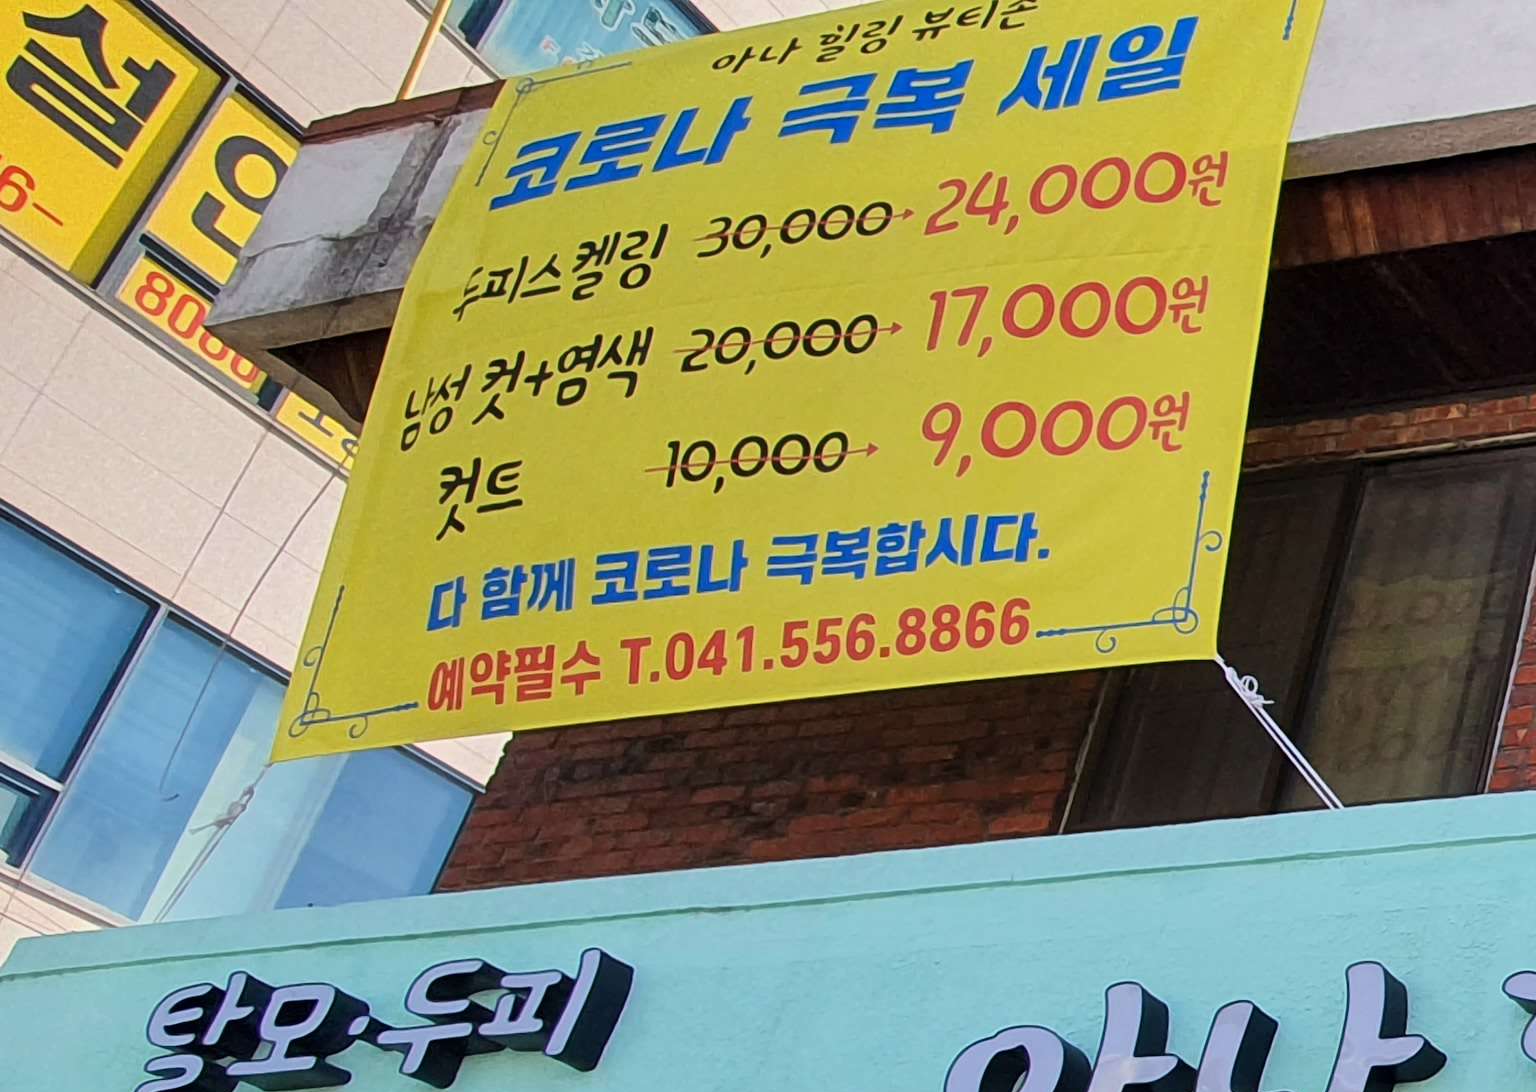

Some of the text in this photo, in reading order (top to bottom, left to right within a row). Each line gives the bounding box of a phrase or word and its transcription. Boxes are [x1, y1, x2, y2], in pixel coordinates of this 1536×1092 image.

[6, 4, 176, 170] 설
[489, 17, 1200, 211] 코로나 극복 세일
[712, 0, 1039, 73] 아나 힐링 뷰티존
[452, 150, 1230, 322] 두피스켈링 30,000 24,000원
[400, 362, 472, 453] 남성
[472, 326, 654, 427] 컷+염색
[680, 313, 879, 376] 20,000
[924, 275, 1208, 359] 17,000원
[435, 391, 1190, 541] 컷트 10,000 9,000원
[426, 513, 1051, 633] 다 함께 코로나 극복합시다.
[426, 597, 1032, 713] 예약필수 T.041.556.8866
